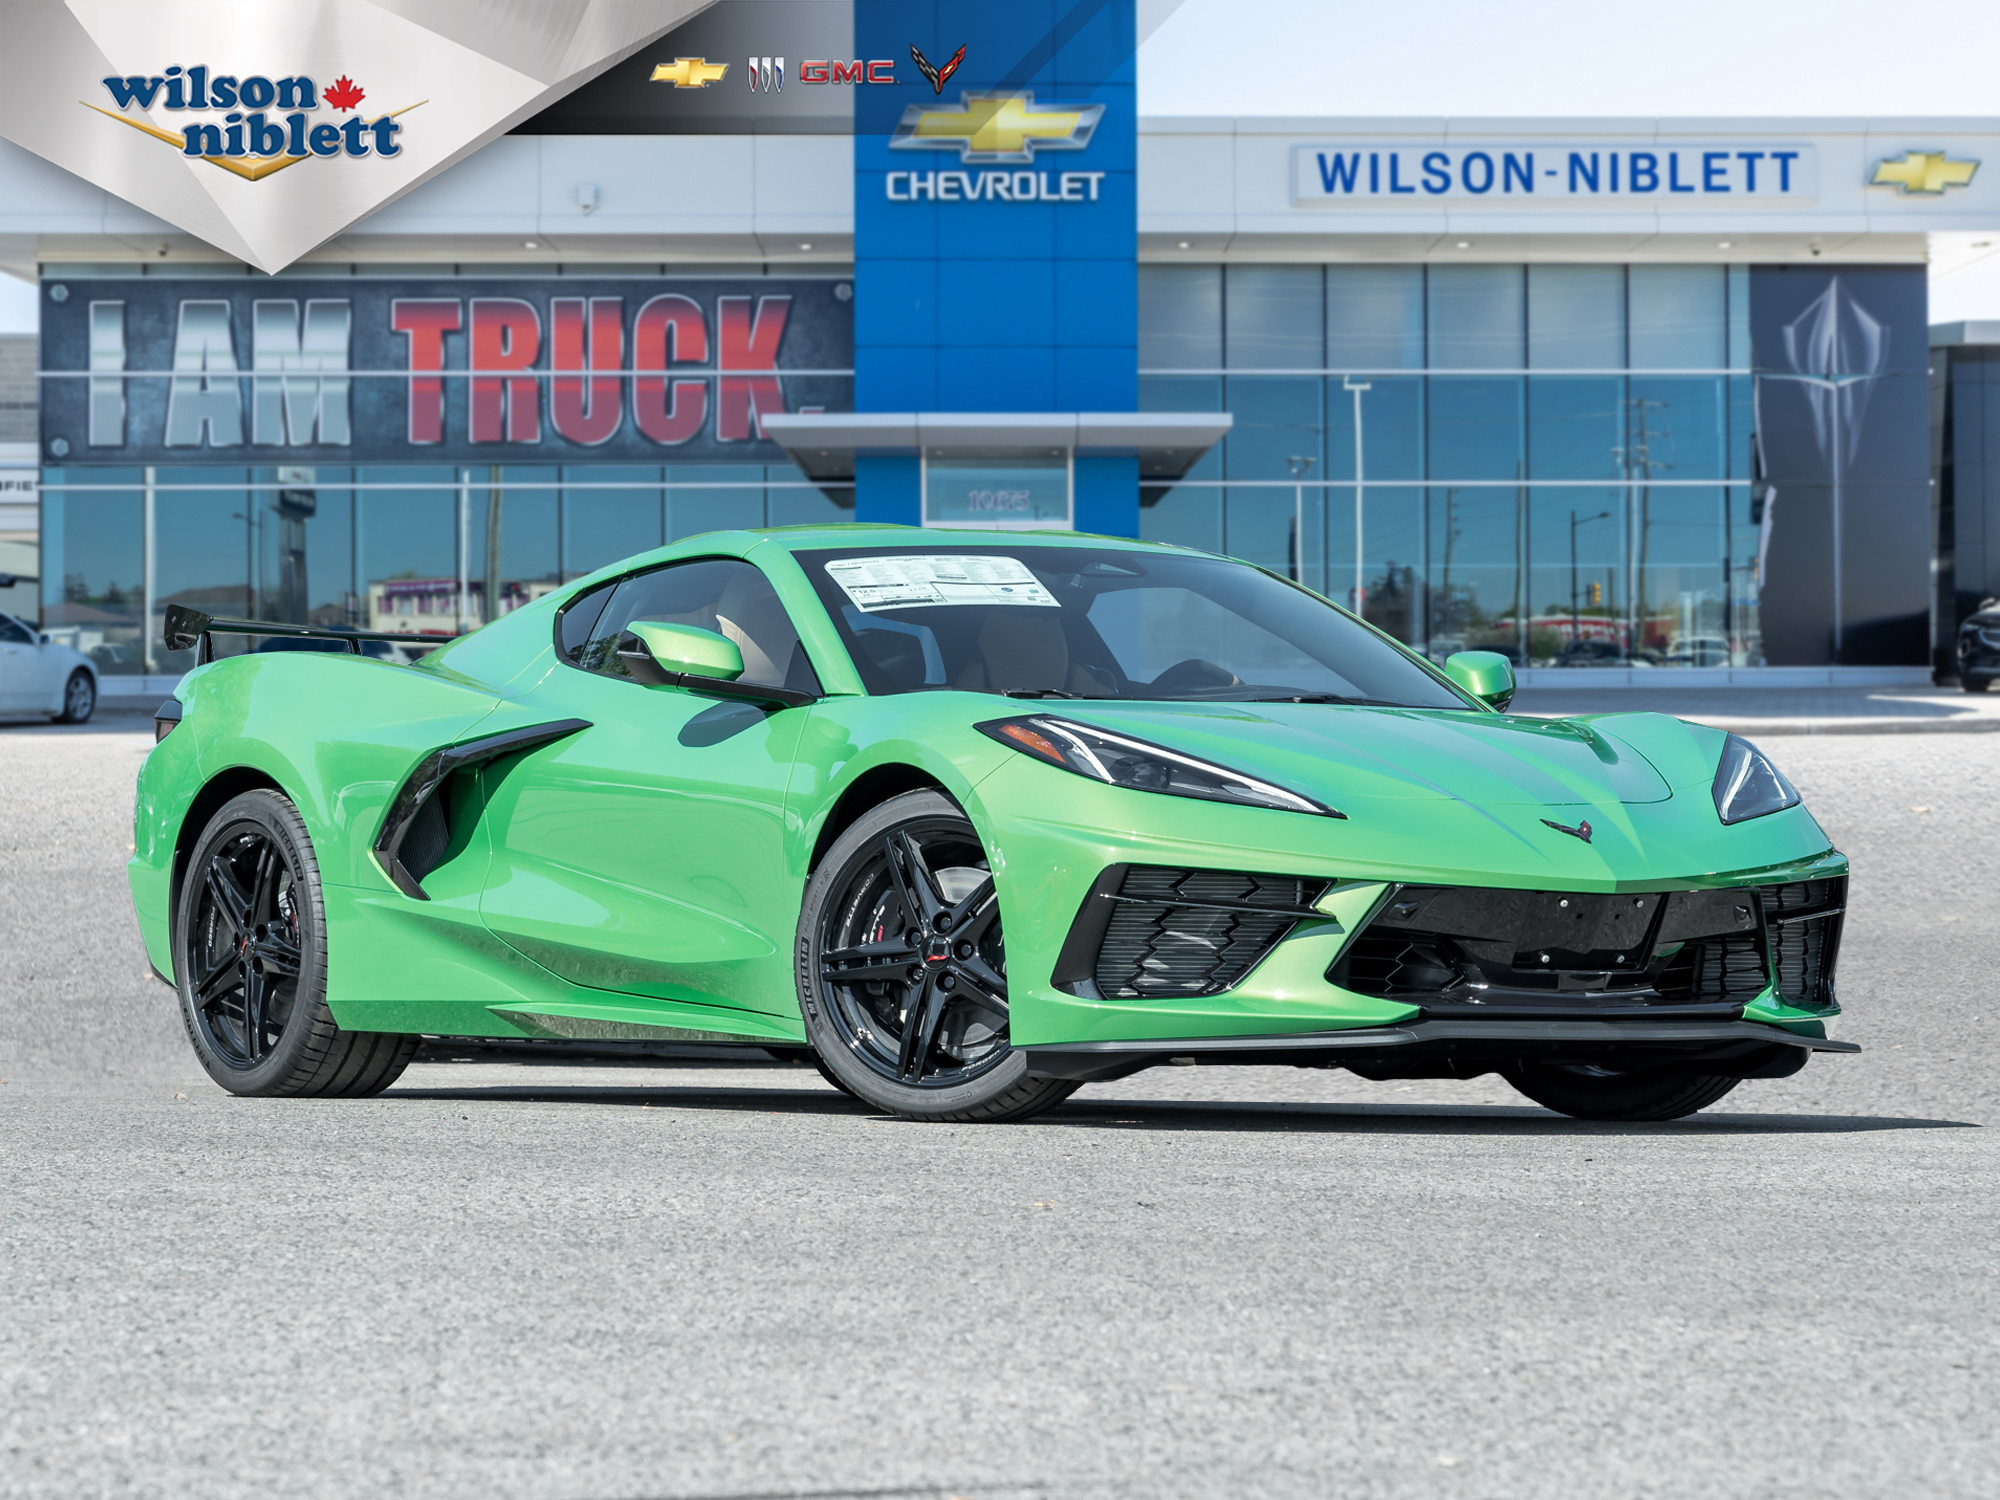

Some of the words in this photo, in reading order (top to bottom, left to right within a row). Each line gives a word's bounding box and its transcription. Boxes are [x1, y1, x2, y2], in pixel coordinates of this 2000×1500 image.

[886, 172, 1105, 201] CHEVROLET
[88, 300, 126, 446] I
[164, 299, 351, 446] AM
[391, 292, 824, 444] TRUCK
[968, 490, 1029, 511] 10675
[801, 941, 817, 1014] MICHELIN
